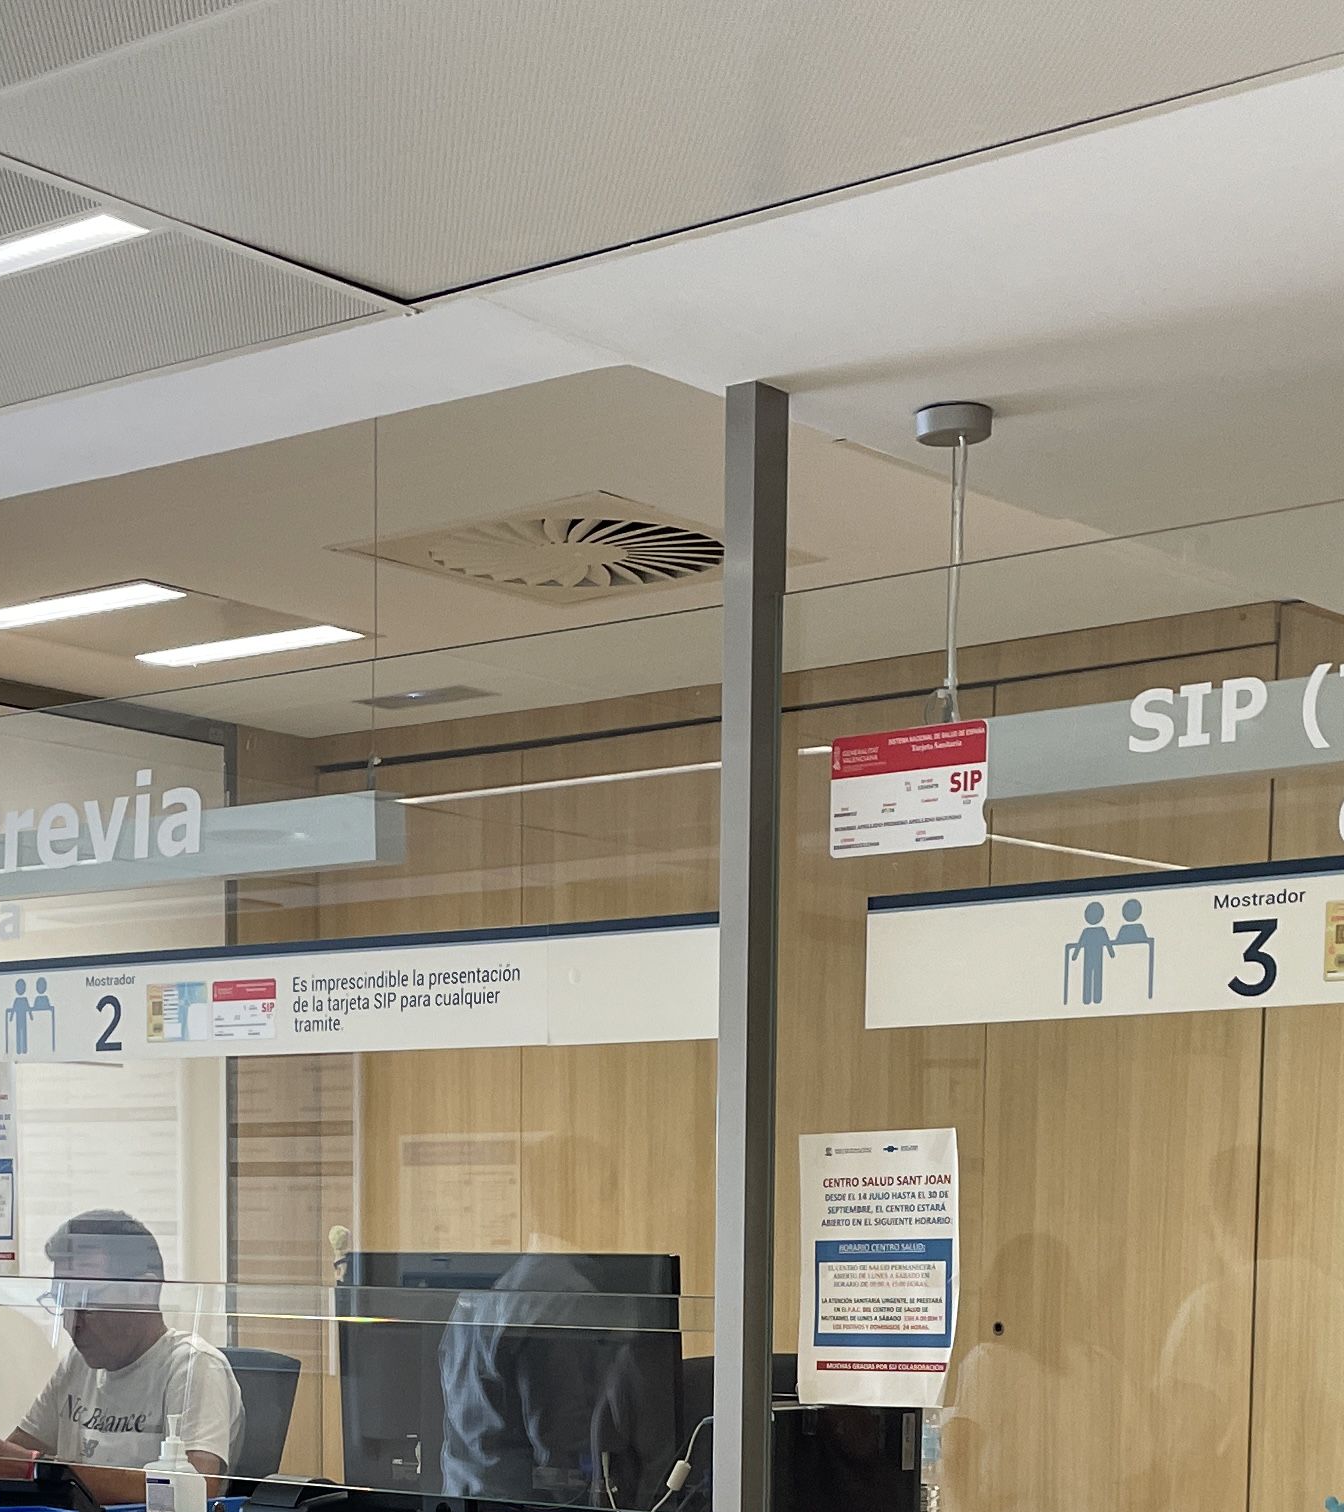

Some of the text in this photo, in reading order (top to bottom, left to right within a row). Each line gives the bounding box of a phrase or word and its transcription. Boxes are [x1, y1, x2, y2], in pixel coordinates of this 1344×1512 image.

[1129, 676, 1268, 754] SIP
[949, 769, 982, 793] SIP
[1212, 889, 1306, 910] Mostrador
[1228, 918, 1278, 997] 3
[85, 974, 136, 988] Mostrador
[292, 964, 520, 996] Es imprescindible la presentación
[292, 988, 500, 1015] de la tarjeta SIP para cualquier
[95, 994, 123, 1052] 2
[294, 1016, 344, 1033] tramite.
[823, 1174, 951, 1188] CENTRO SALUD SANT JOAN
[825, 1193, 846, 1201] DESDE
[848, 1193, 855, 1201] EL
[869, 1192, 890, 1200] JULIO
[892, 1191, 916, 1200] HASTA
[918, 1191, 926, 1199] EL
[939, 1190, 949, 1198] DE
[876, 1205, 883, 1213] EL
[885, 1204, 915, 1212] CENTRO
[917, 1202, 946, 1211] ESTARÁ
[821, 1219, 850, 1227] ABIERTO
[852, 1218, 862, 1226] EN
[864, 1218, 872, 1226] EL
[874, 1217, 912, 1226] SIGUIENTE
